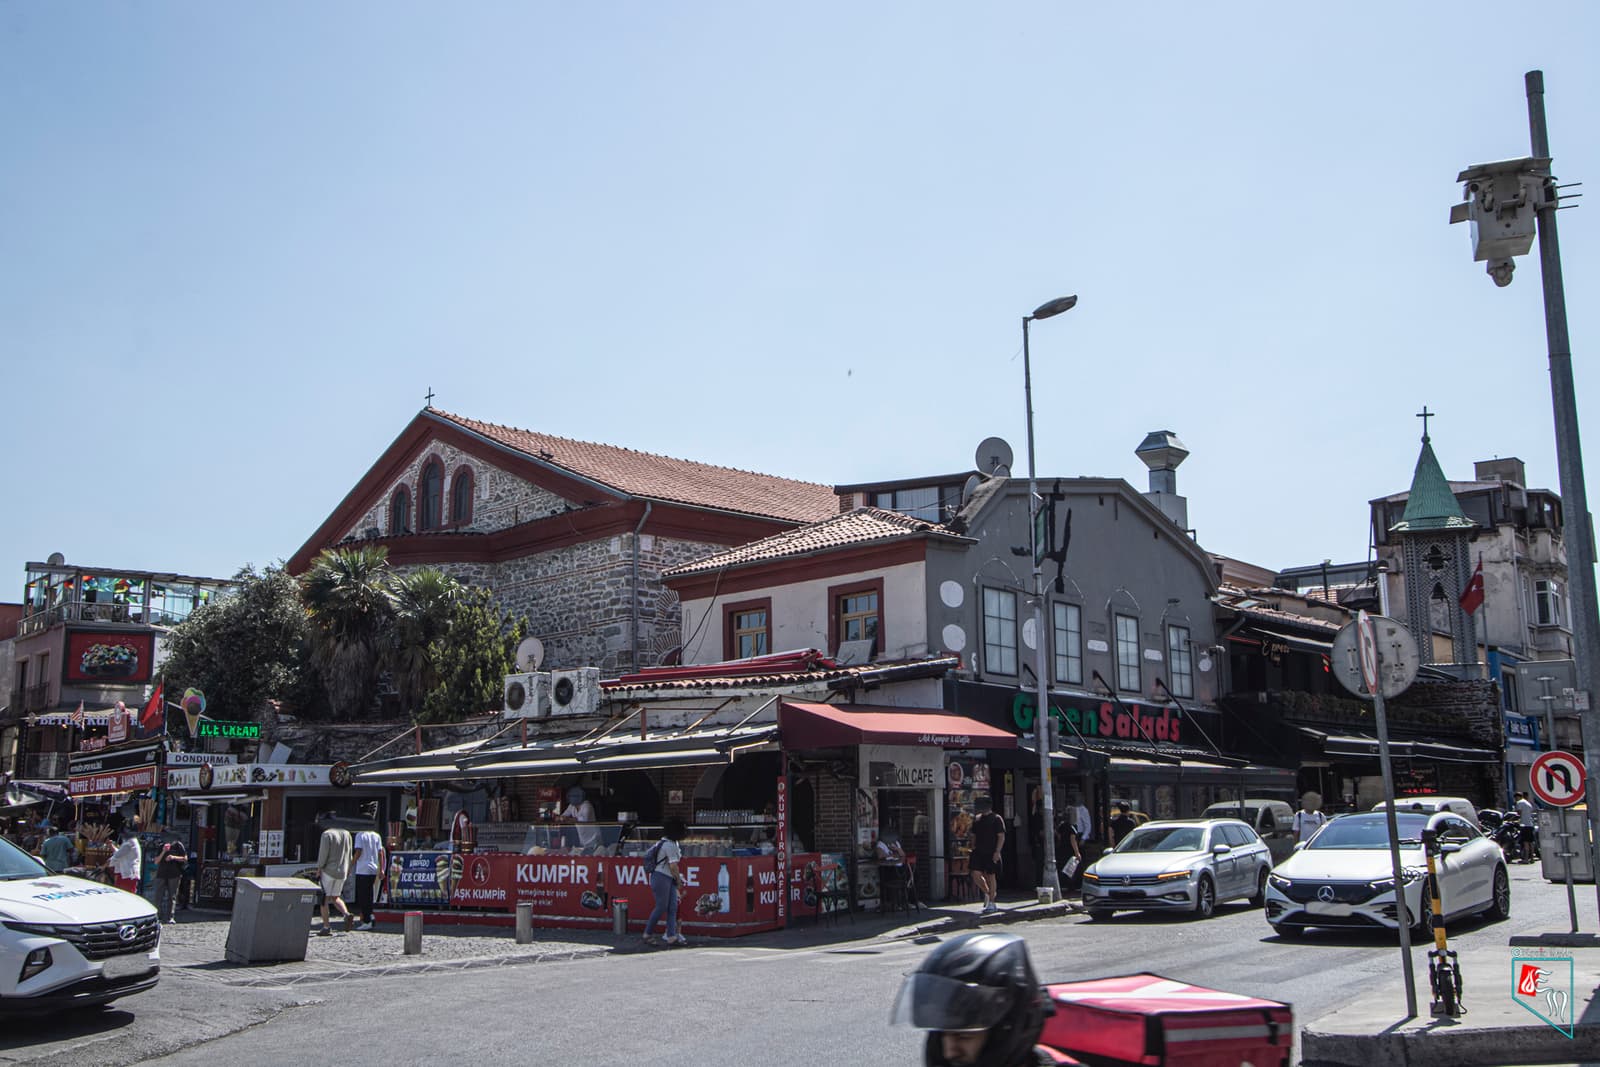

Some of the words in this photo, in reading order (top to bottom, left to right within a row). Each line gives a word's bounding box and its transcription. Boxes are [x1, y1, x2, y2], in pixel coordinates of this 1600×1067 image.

[1099, 702, 1181, 742] Salads
[175, 755, 230, 764] DONDURMA
[911, 769, 934, 784] CAFE
[401, 873, 412, 882] ICE
[413, 873, 435, 882] CREAM
[516, 860, 589, 884] KUMPİR
[454, 888, 471, 901] AŞK
[472, 888, 506, 900] KUMPİR
[777, 862, 785, 917] WAFFLE
